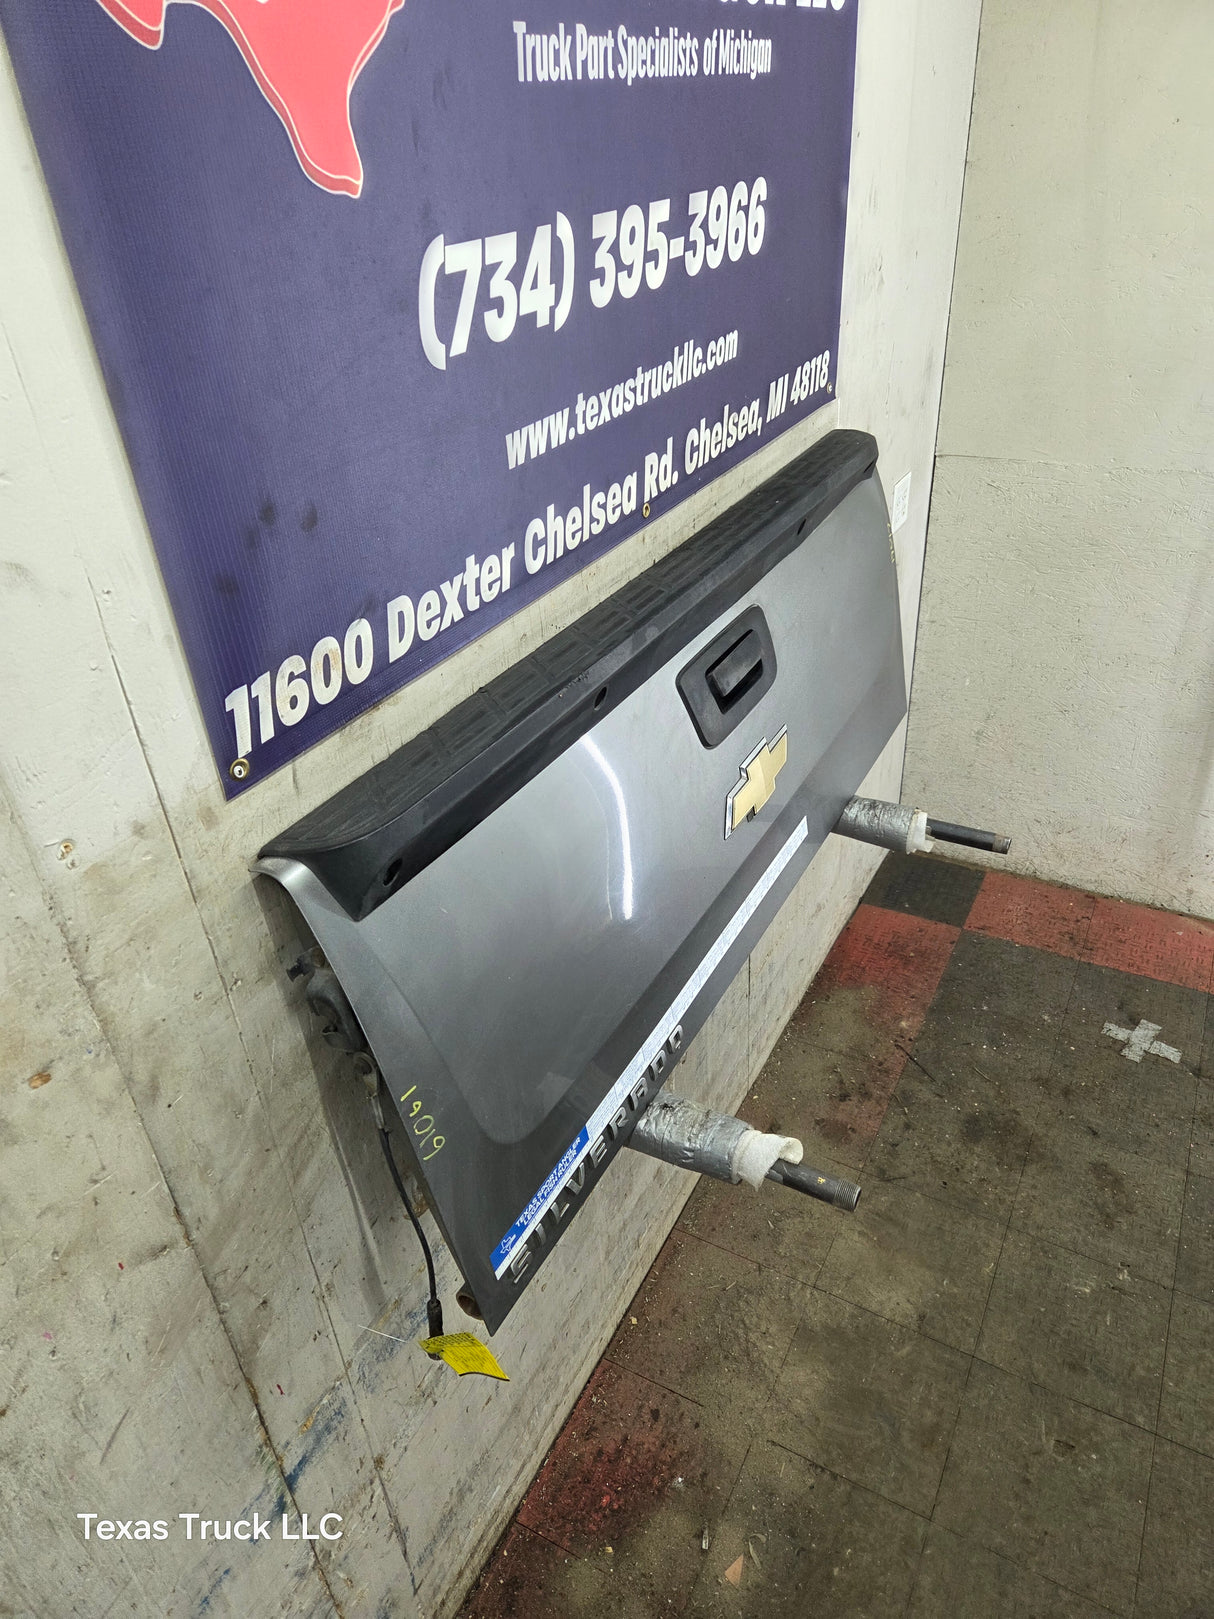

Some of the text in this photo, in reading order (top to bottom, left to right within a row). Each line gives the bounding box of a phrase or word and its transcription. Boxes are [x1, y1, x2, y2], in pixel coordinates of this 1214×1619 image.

[513, 21, 772, 86] Truck Part Specialists of Michigan
[418, 176, 768, 371] (734) 395-3966
[505, 329, 739, 470] www.texastruckllc.com
[224, 349, 831, 759] 11600 Dexter Chelsea Rd. Chelsea, MI 48118
[400, 1085, 446, 1161] 19019
[510, 1024, 683, 1284] SILVERADO
[514, 1135, 581, 1229] TEXAS SPORT ANGLER
